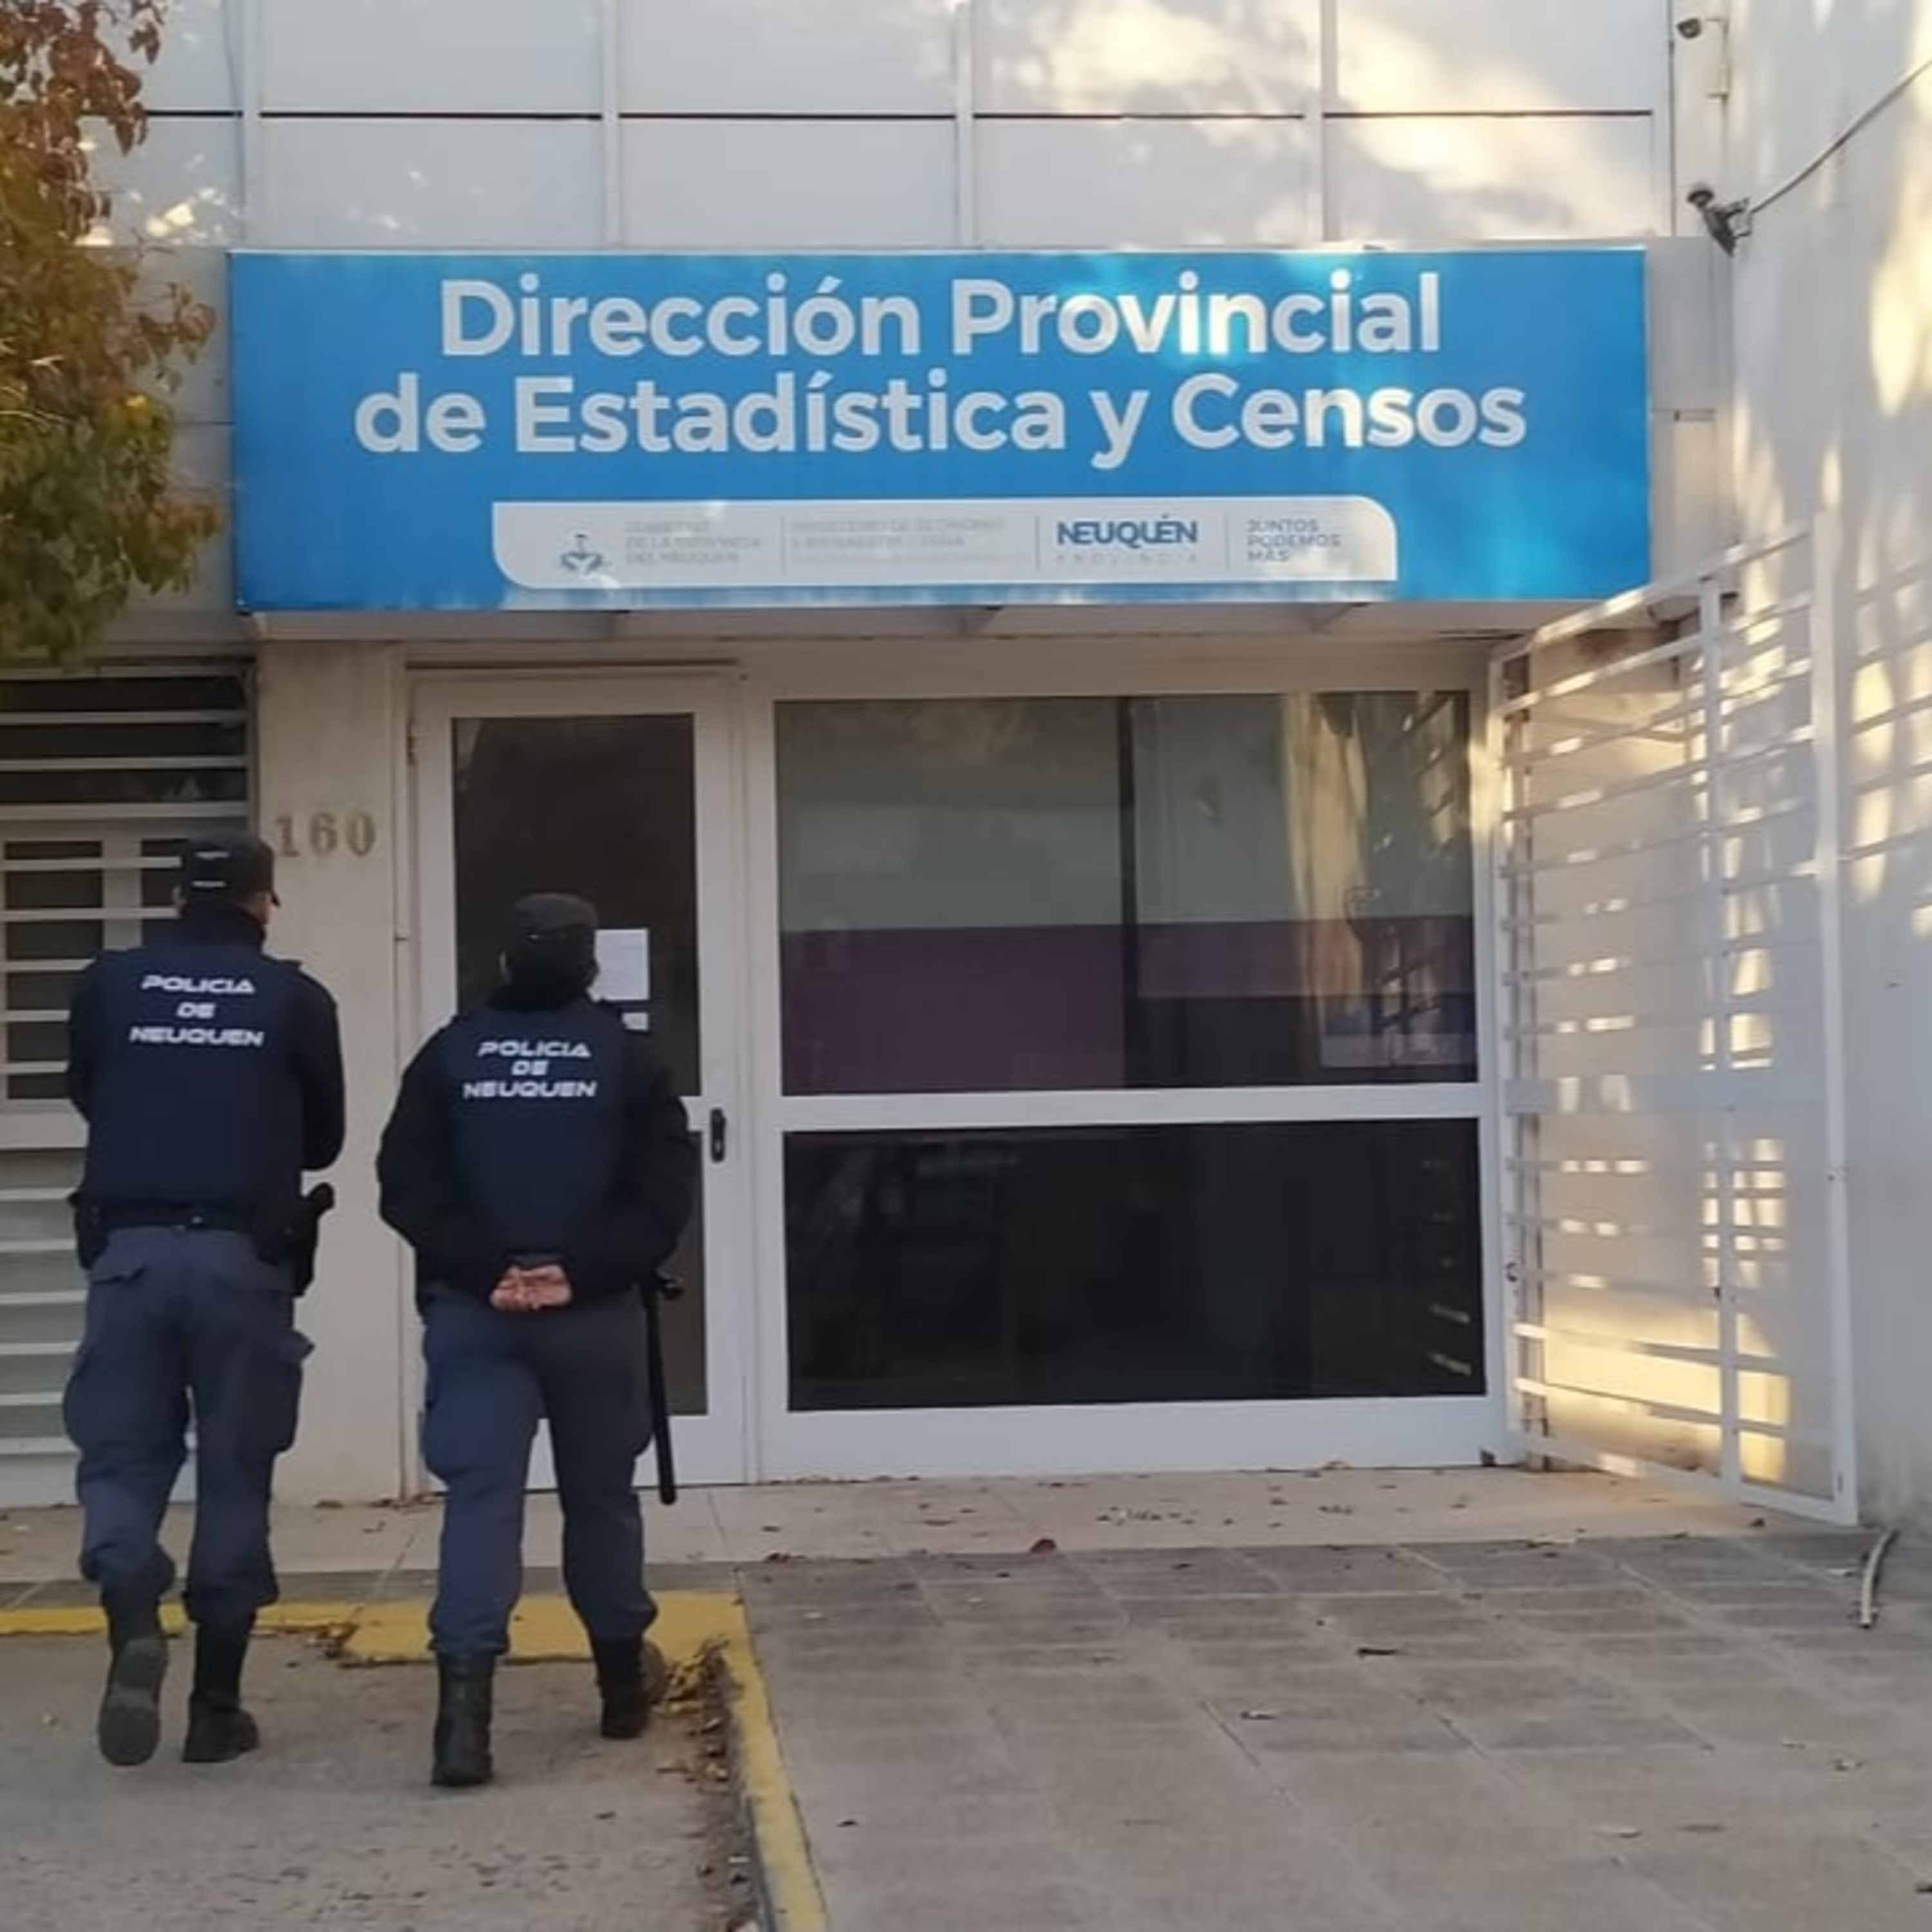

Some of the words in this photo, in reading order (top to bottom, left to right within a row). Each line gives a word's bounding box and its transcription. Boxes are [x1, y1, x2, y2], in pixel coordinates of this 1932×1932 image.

[442, 272, 921, 357] Dirección
[952, 269, 1440, 355] Provincial
[354, 372, 486, 453] de
[515, 367, 1066, 453] Estadística
[1088, 390, 1150, 470] y
[1172, 373, 1526, 449] Censos
[1057, 513, 1198, 549] NEUQUÉN
[1247, 534, 1342, 547] PODEMOS
[275, 813, 376, 857] 160
[140, 974, 256, 994] POLICIA
[176, 1001, 216, 1019] DE
[129, 1027, 264, 1046] NEUQUEN
[477, 1040, 592, 1058] POLICIA
[511, 1060, 549, 1076] DE
[462, 1080, 598, 1099] NEUQUEN
